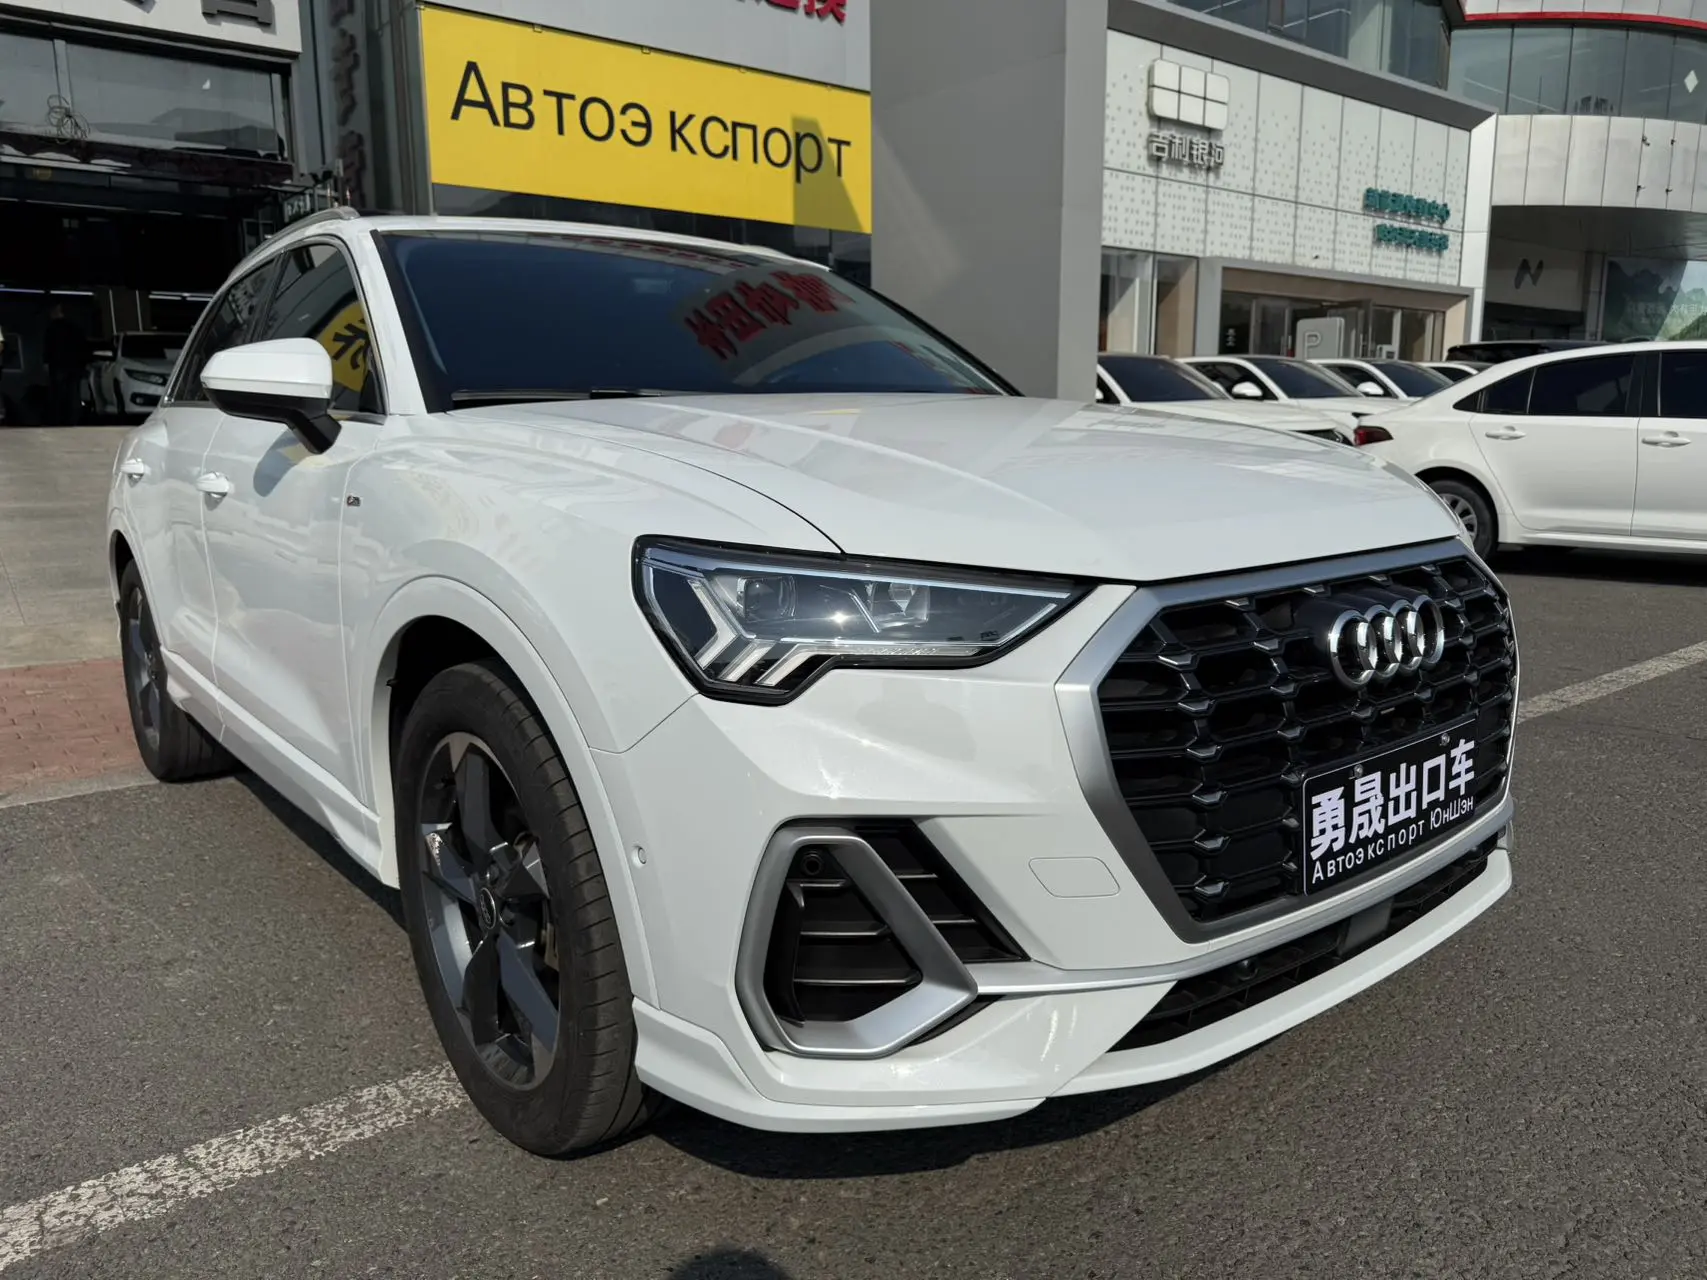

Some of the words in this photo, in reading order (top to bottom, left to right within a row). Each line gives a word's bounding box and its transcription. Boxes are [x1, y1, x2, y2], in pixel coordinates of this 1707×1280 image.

[1150, 133, 1224, 166] 吉利银河
[1309, 738, 1476, 861] 勇晟出口车
